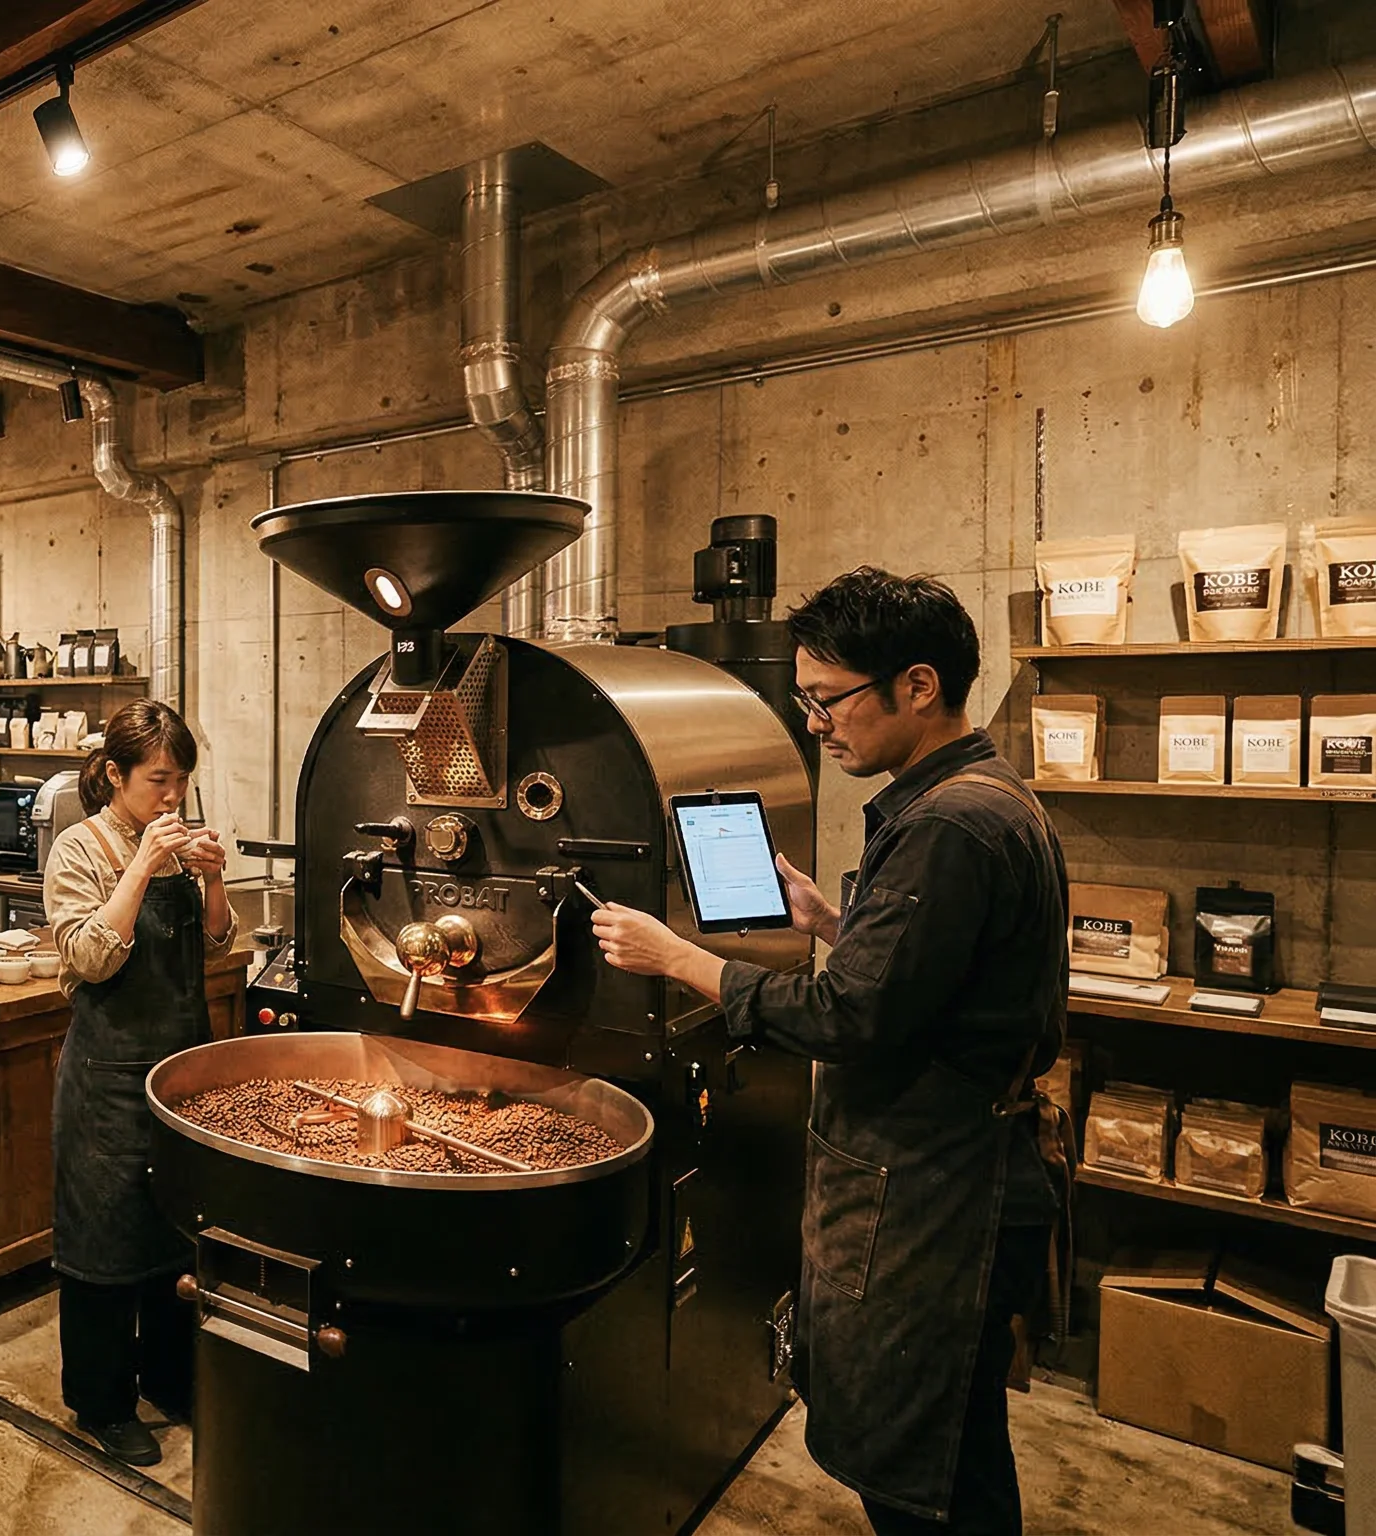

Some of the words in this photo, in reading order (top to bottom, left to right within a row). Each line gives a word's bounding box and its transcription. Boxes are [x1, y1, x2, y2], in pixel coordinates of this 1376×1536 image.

[1203, 572, 1260, 588] KOBE
[1058, 581, 1106, 594] KOBE
[1173, 737, 1210, 746] KOBE
[1247, 738, 1285, 747] KOBE
[409, 880, 510, 913] PROBAT
[1082, 919, 1124, 933] KOBE
